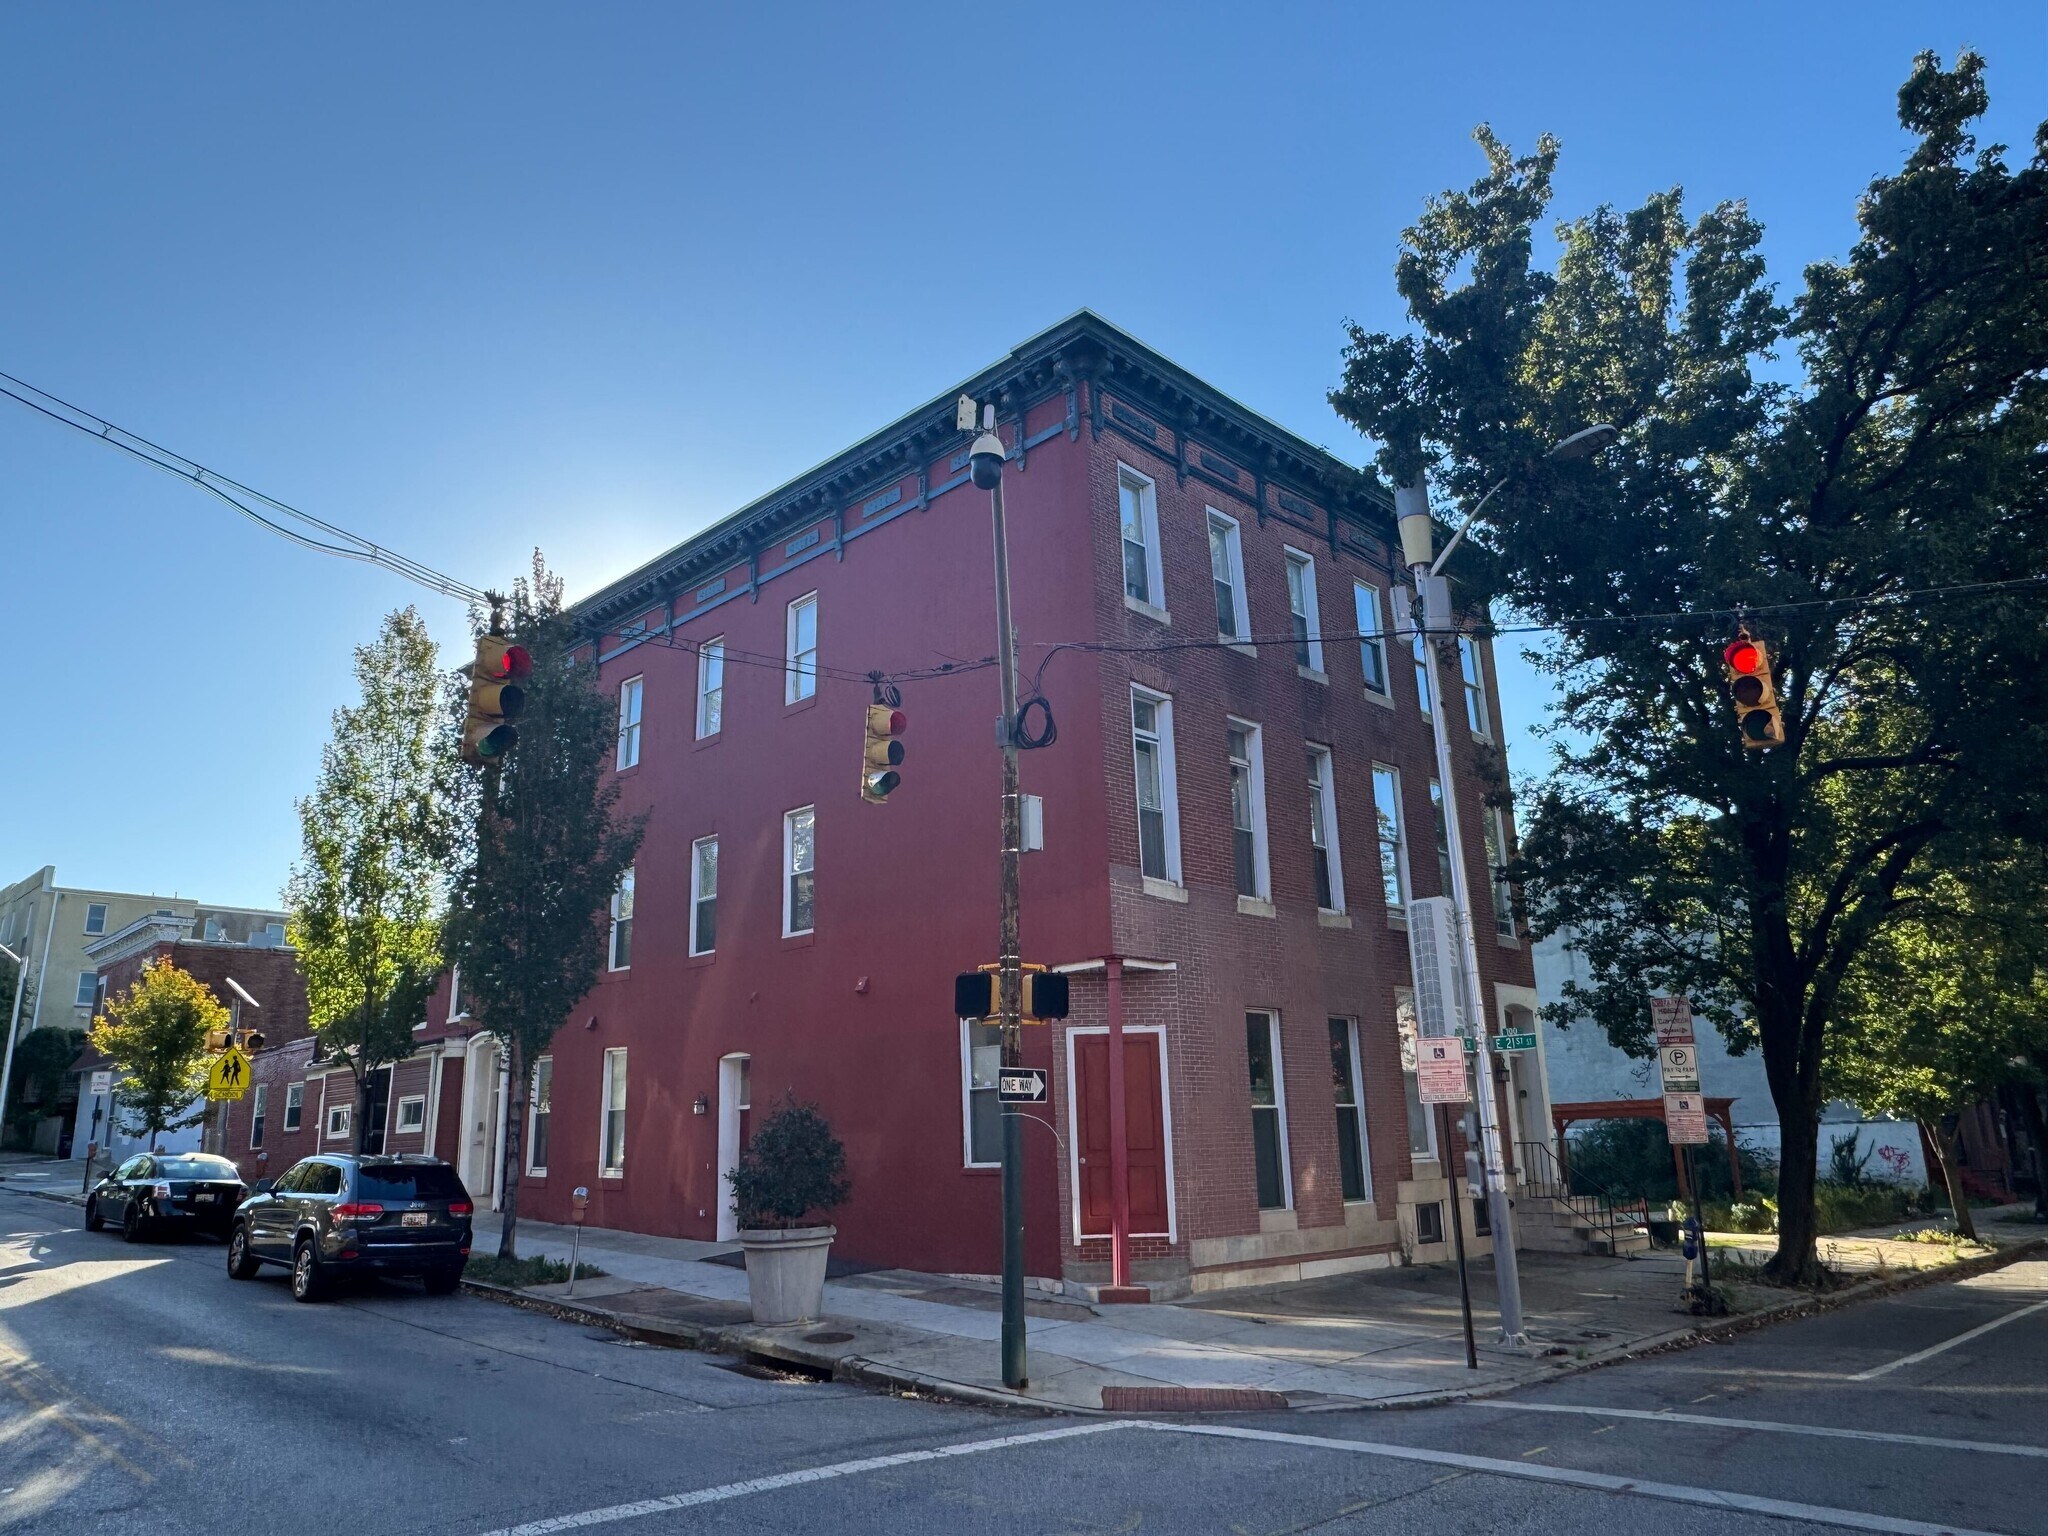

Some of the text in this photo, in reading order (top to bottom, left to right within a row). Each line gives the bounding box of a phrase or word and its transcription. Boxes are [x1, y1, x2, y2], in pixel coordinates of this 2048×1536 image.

[1505, 1027, 1518, 1036] 100
[1495, 1038, 1504, 1050] E
[1674, 1051, 1684, 1064] P
[1002, 1078, 1033, 1092] ONE WAY
